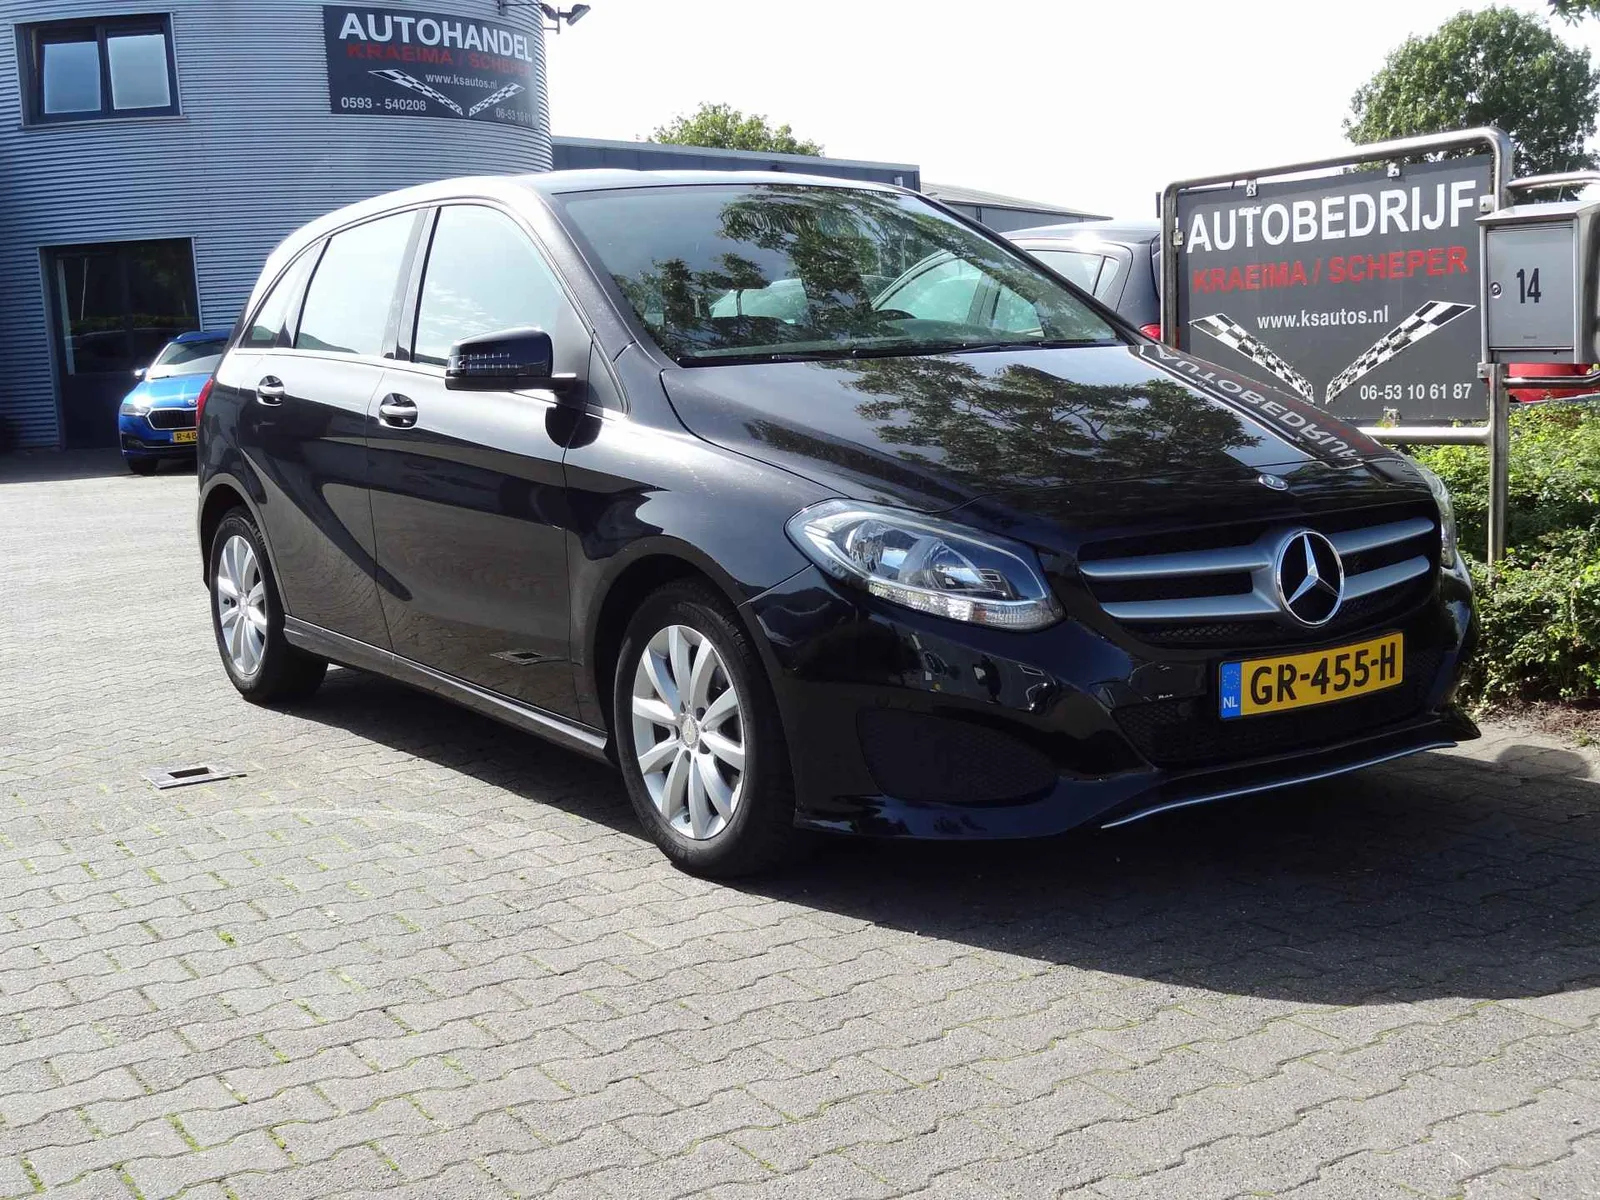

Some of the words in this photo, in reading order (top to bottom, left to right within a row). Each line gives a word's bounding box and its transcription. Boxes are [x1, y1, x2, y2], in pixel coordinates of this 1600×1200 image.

[338, 12, 533, 62] AUTOHANDEL
[425, 73, 498, 90] www.ksautos.nl
[341, 97, 373, 109] 0593
[385, 99, 427, 112] 540208
[1187, 180, 1476, 254] AUTOBEDRIJF
[1313, 260, 1321, 282] /
[1329, 246, 1469, 282] SCHEPER
[1516, 268, 1541, 304] 14
[1257, 305, 1389, 330] www.ksautos.nl
[1360, 384, 1402, 400] 06-53
[1408, 384, 1425, 399] 10
[1429, 383, 1446, 400] 61
[1453, 383, 1472, 399] 87
[1251, 642, 1396, 706] GR-455-H
[1223, 696, 1238, 709] NL
